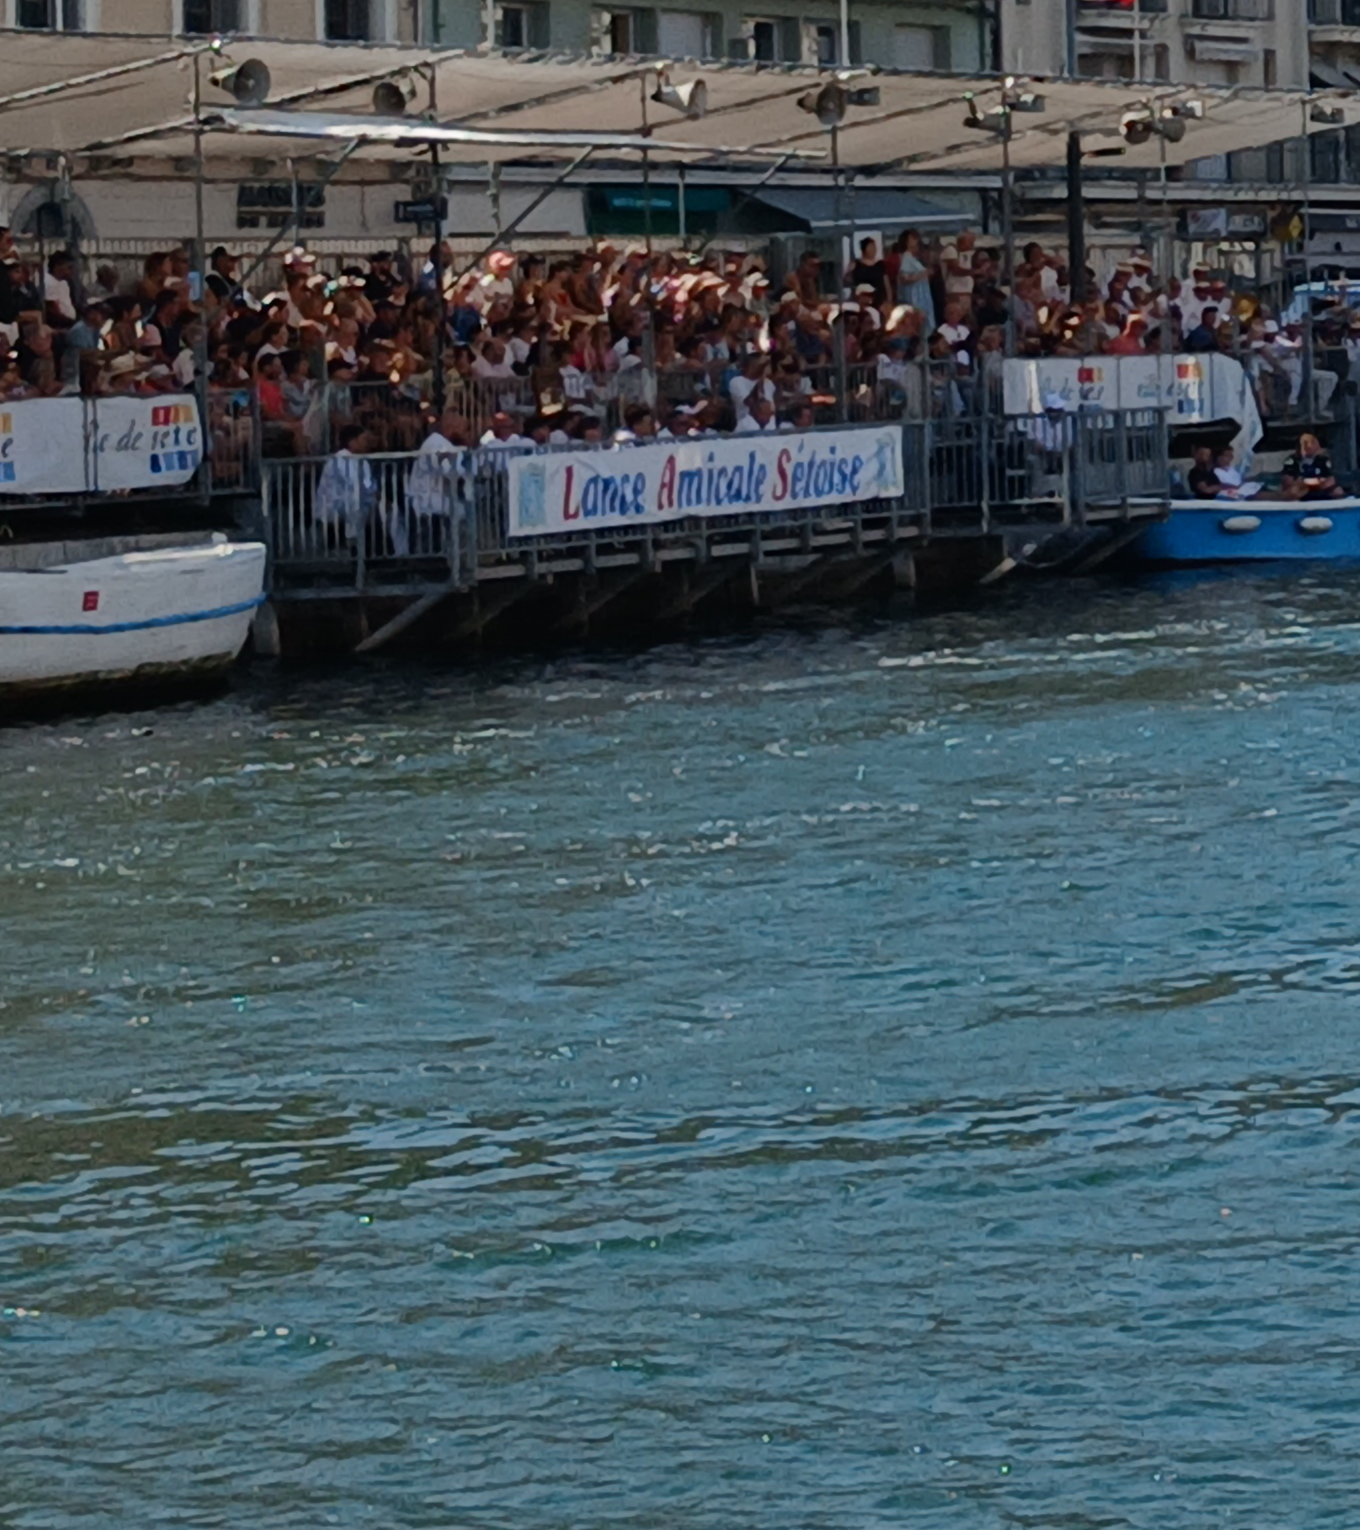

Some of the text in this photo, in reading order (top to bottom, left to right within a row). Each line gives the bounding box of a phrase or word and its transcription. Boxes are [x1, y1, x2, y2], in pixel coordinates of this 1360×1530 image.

[562, 438, 864, 521] Lance Amicale Sétoise
